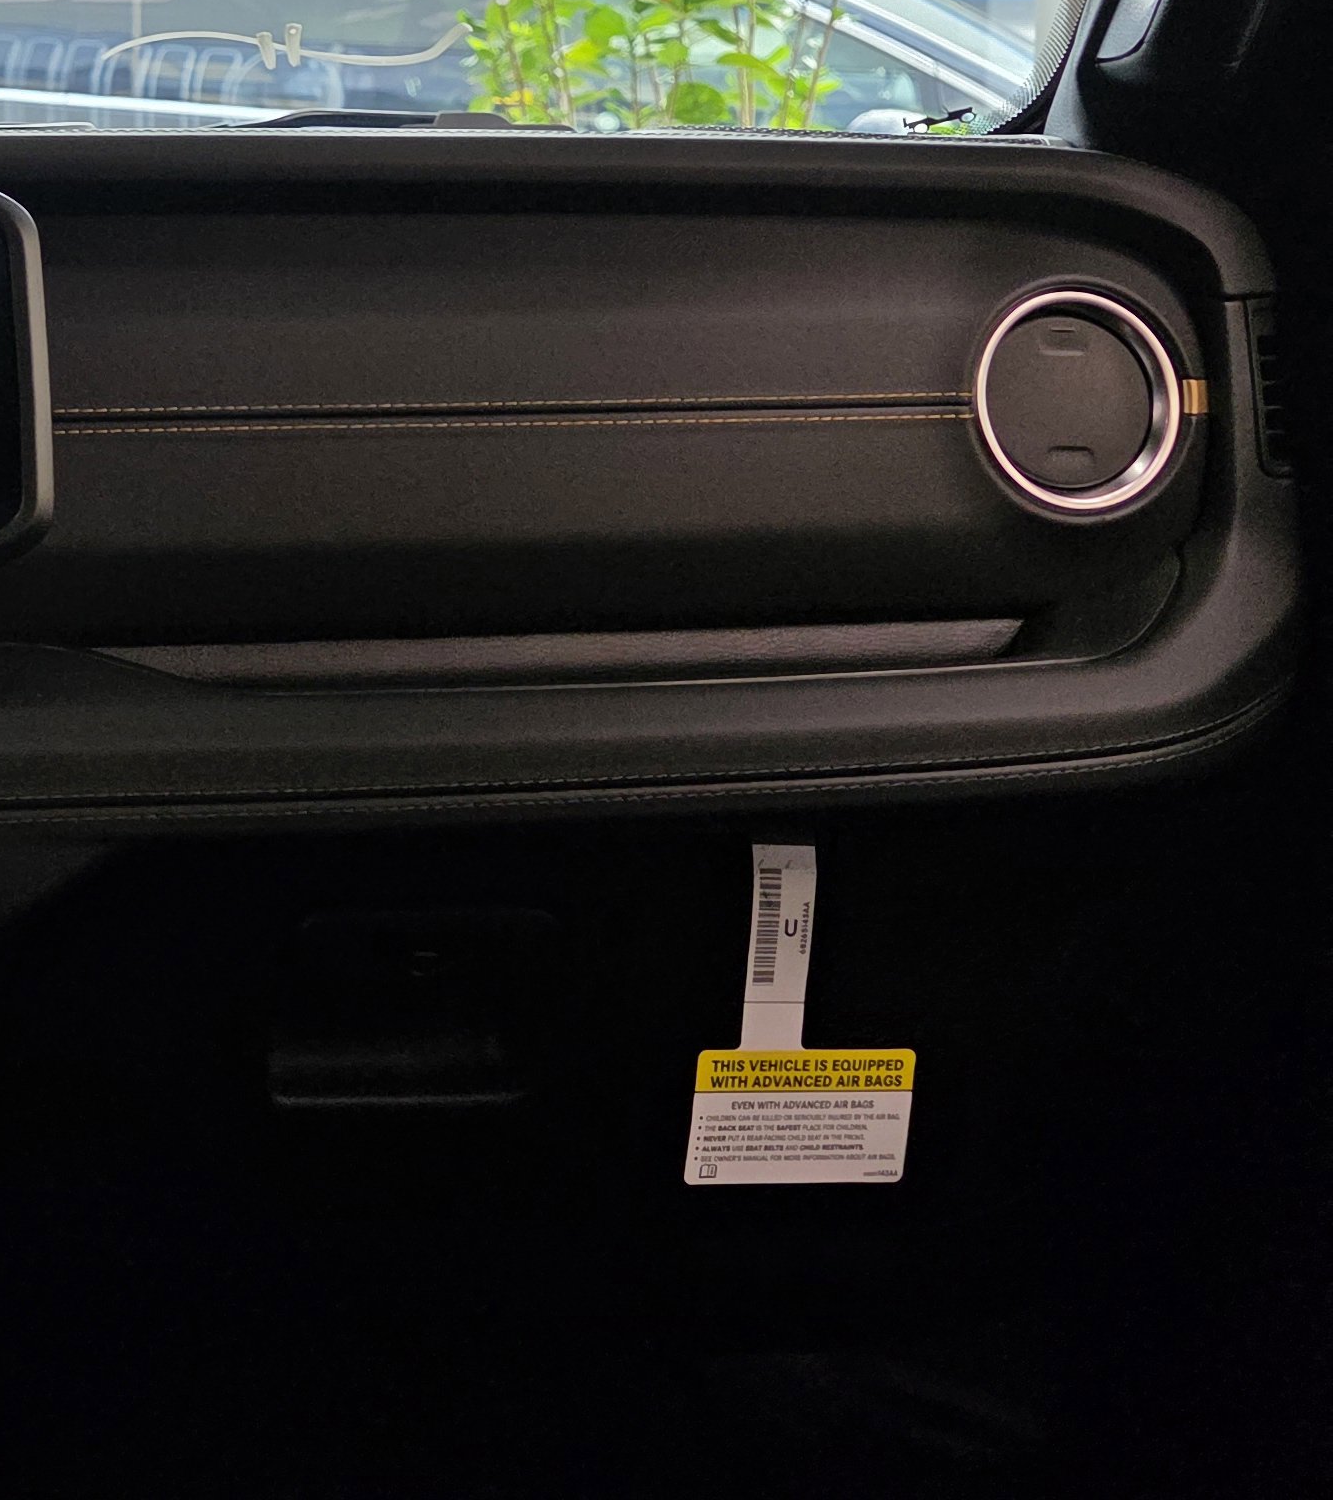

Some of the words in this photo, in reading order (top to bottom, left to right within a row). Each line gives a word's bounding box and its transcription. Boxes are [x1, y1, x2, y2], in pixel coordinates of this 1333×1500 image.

[711, 1059, 745, 1073] THIS
[749, 1059, 811, 1072] VEHICLE
[814, 1059, 828, 1071] IS
[832, 1058, 905, 1072] EQUIPPED
[710, 1075, 748, 1089] WITH
[751, 1075, 833, 1088] ADVANCED
[835, 1075, 861, 1088] AIR
[863, 1074, 903, 1087] BAGS
[731, 1101, 755, 1110] EVEN
[757, 1101, 781, 1110] WITH
[782, 1100, 831, 1110] ADVANCED
[833, 1100, 848, 1109] AIR
[850, 1100, 875, 1109] BAGS
